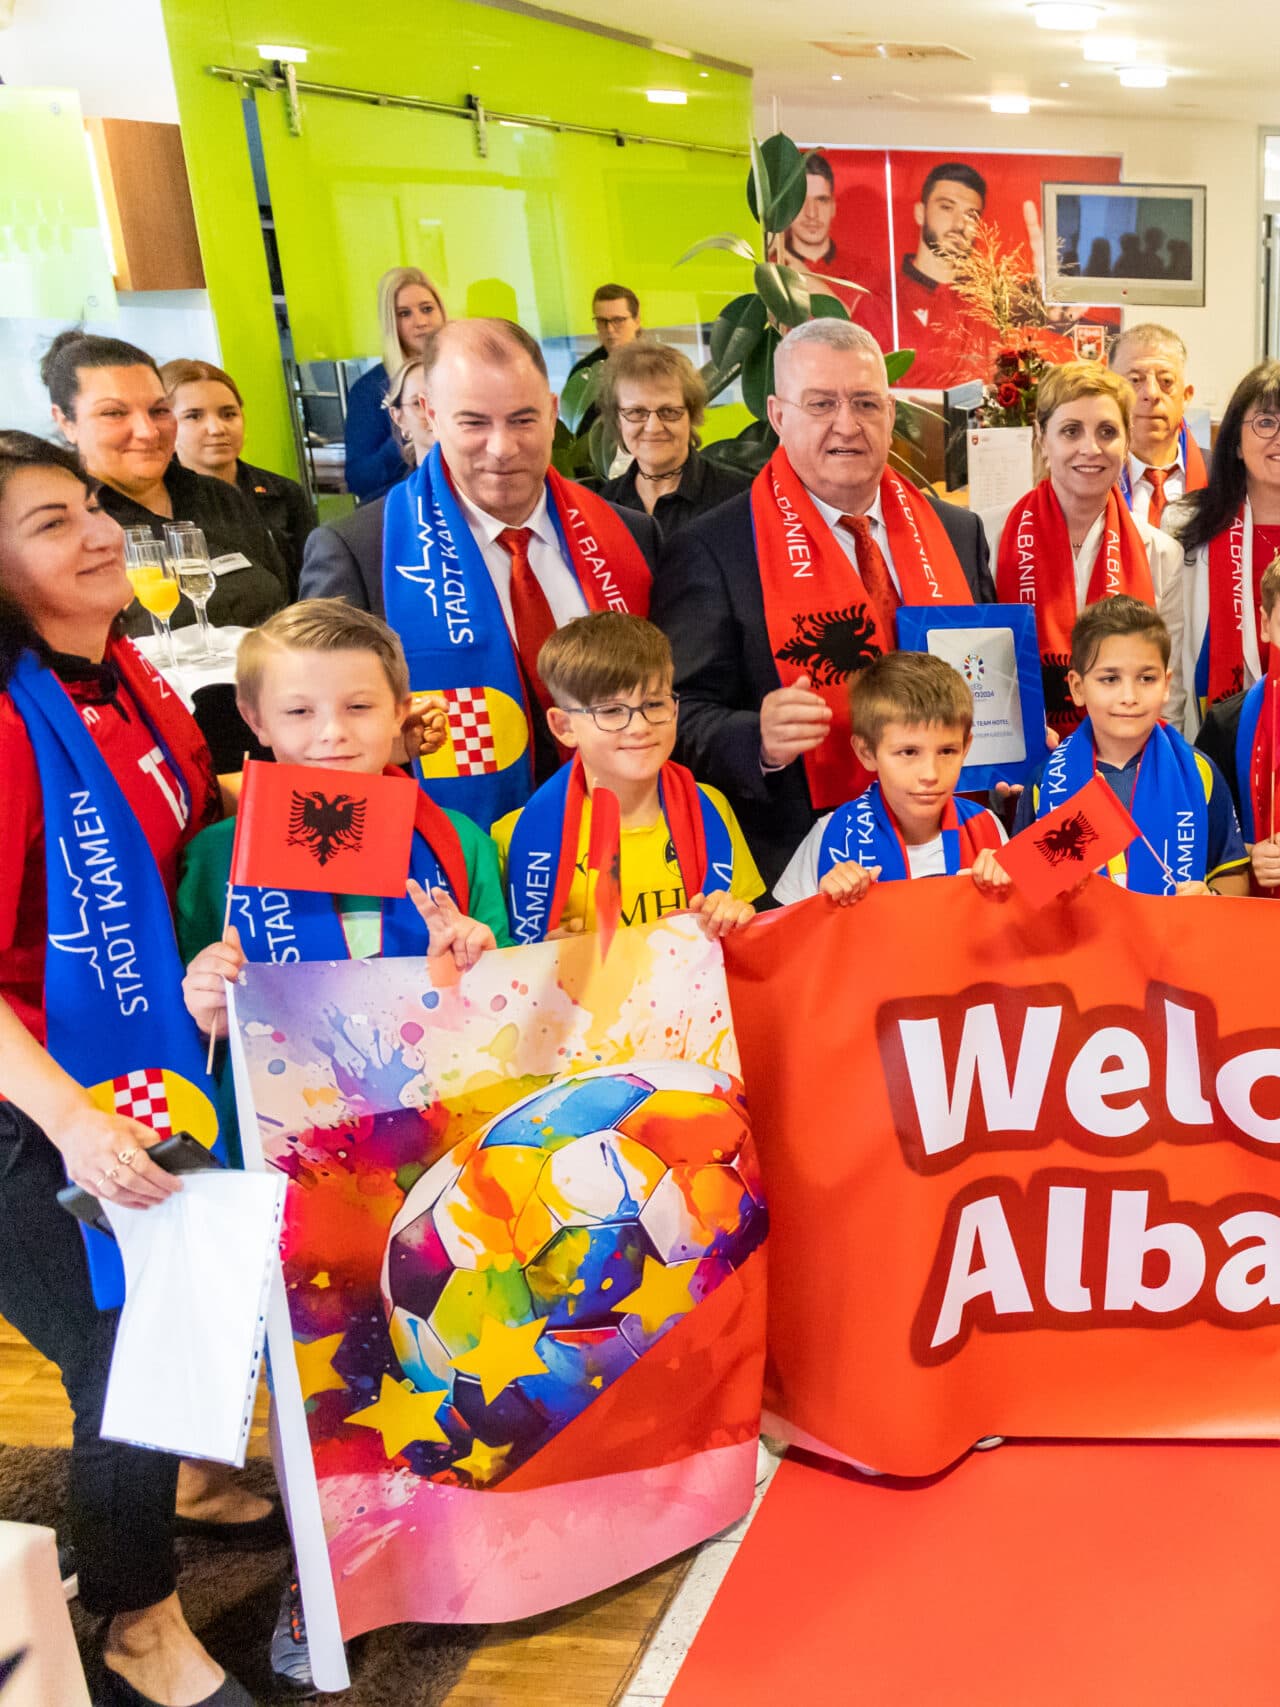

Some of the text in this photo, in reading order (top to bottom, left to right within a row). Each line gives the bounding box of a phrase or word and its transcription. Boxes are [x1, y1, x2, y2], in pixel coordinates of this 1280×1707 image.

[1017, 510, 1036, 606] ALBANIE
[442, 561, 474, 644] STADT
[1176, 811, 1196, 884] AMEN
[69, 790, 149, 1017] STADT KAMEN
[258, 886, 301, 966] STAD
